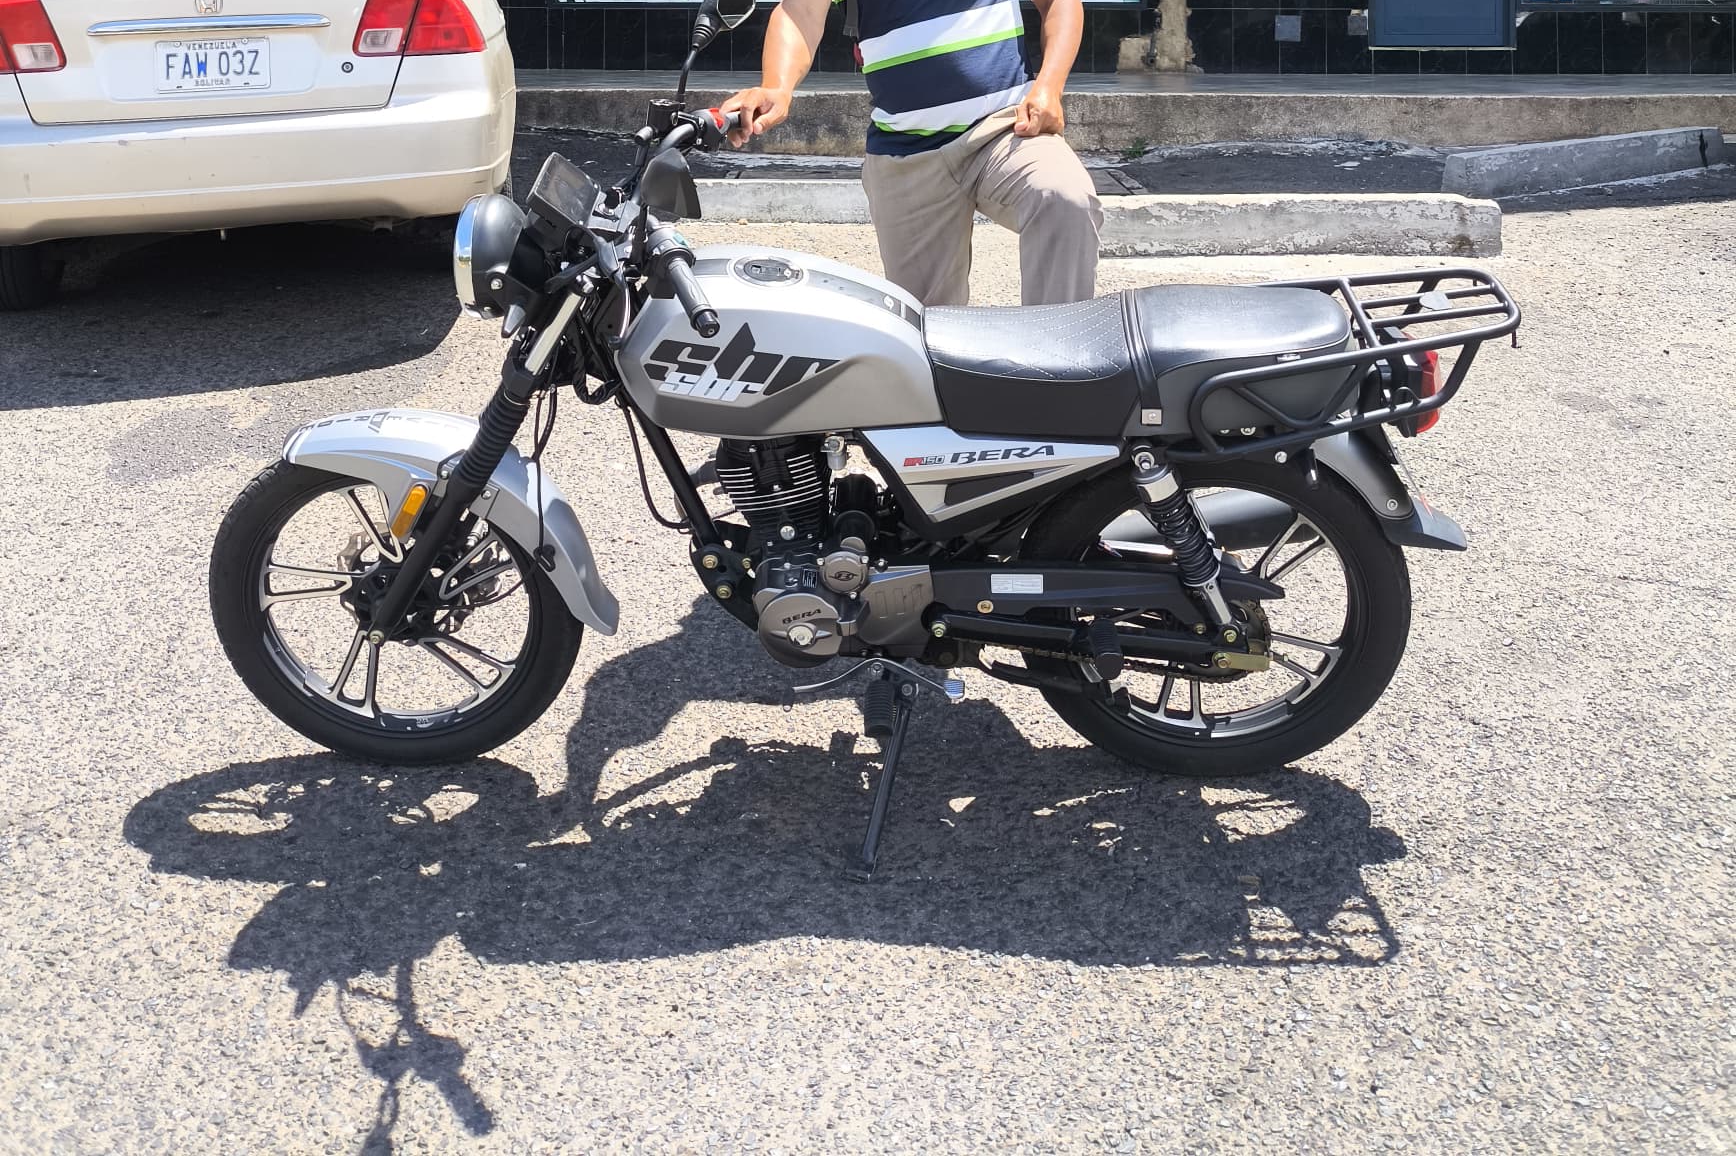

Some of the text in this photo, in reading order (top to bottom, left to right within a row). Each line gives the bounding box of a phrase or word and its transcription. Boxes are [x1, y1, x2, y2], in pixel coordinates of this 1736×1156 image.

[187, 41, 237, 50] VENEZUELA
[165, 49, 260, 80] FAW 03Z
[950, 445, 1055, 465] BERA
[782, 608, 822, 624] BERA
